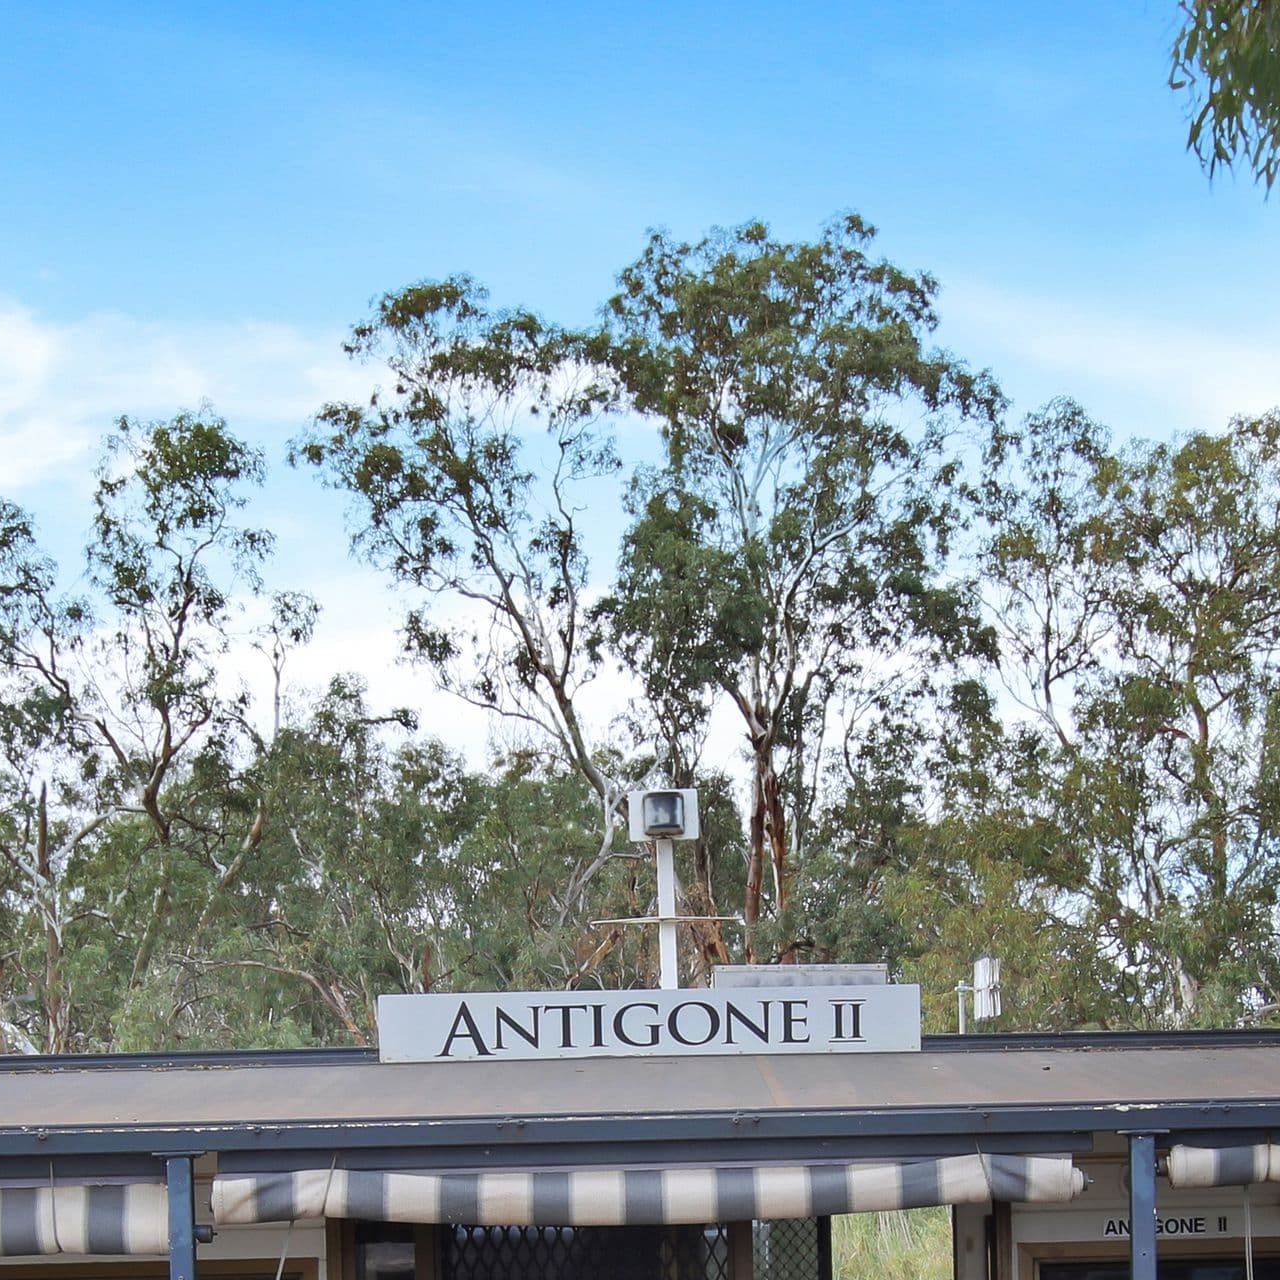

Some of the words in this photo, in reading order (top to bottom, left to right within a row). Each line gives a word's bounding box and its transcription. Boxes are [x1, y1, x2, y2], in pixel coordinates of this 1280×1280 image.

[435, 1000, 811, 1057] ANTIGONE
[828, 999, 867, 1042] II
[1105, 1218, 1205, 1235] ANGONE
[1218, 1217, 1227, 1232] II
